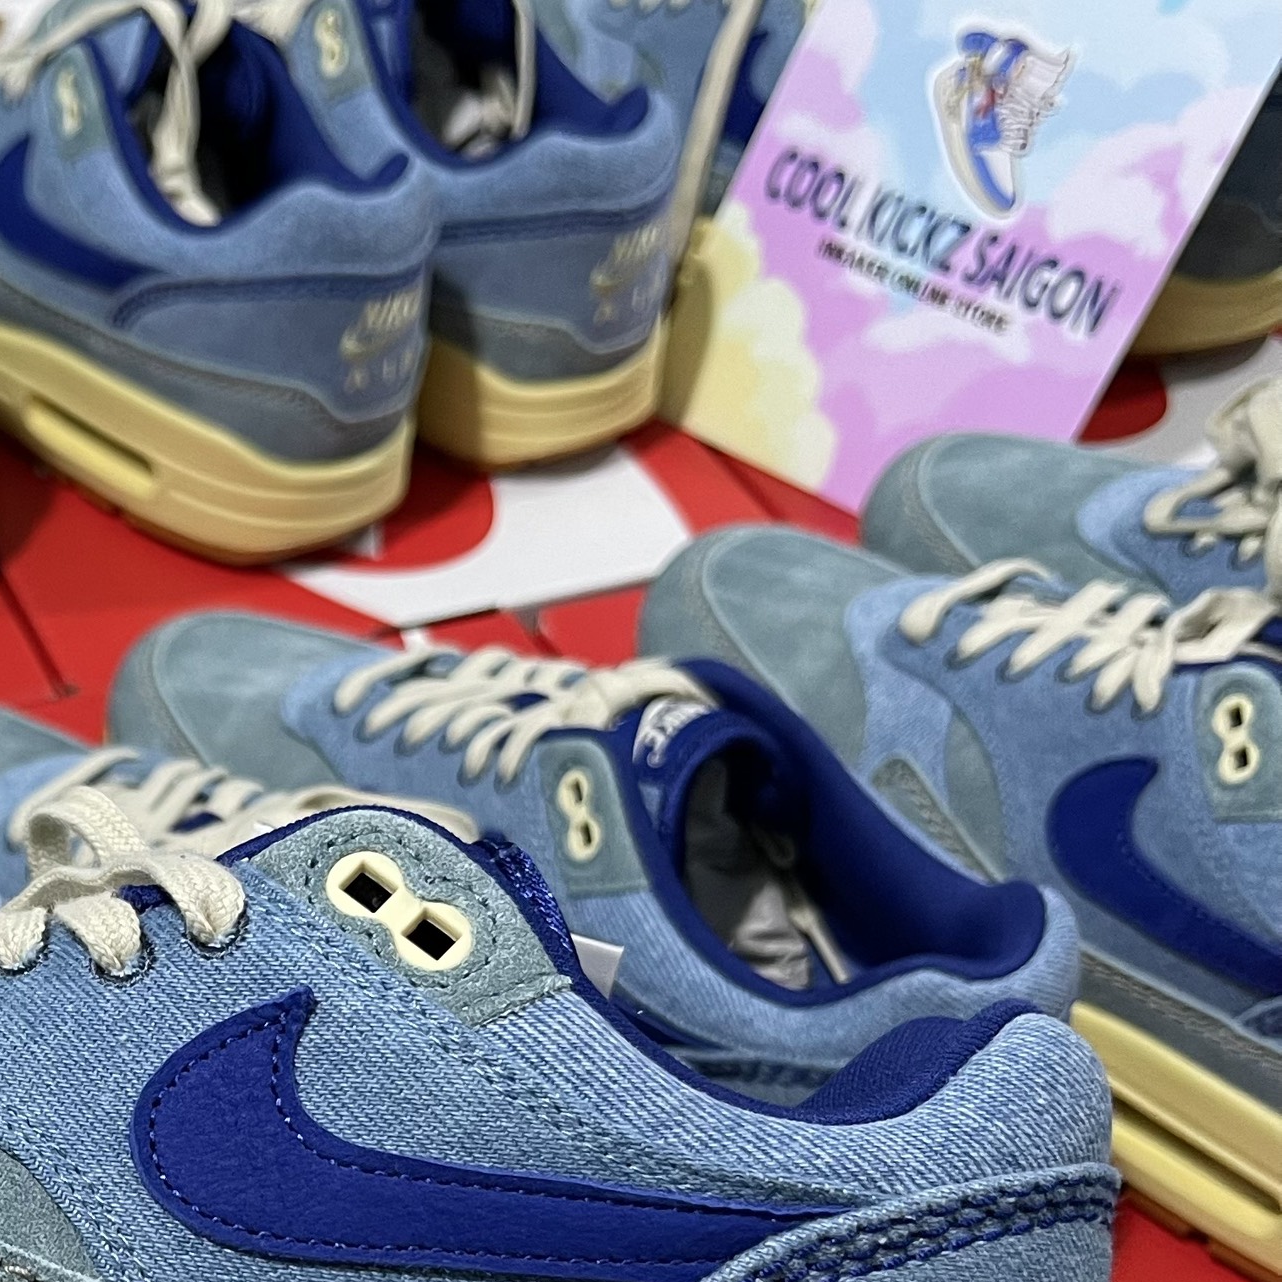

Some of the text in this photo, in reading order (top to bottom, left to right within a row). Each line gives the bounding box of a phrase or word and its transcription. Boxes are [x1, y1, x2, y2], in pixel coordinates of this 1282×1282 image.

[764, 147, 1122, 334] COOL KICKZ SAIGON
